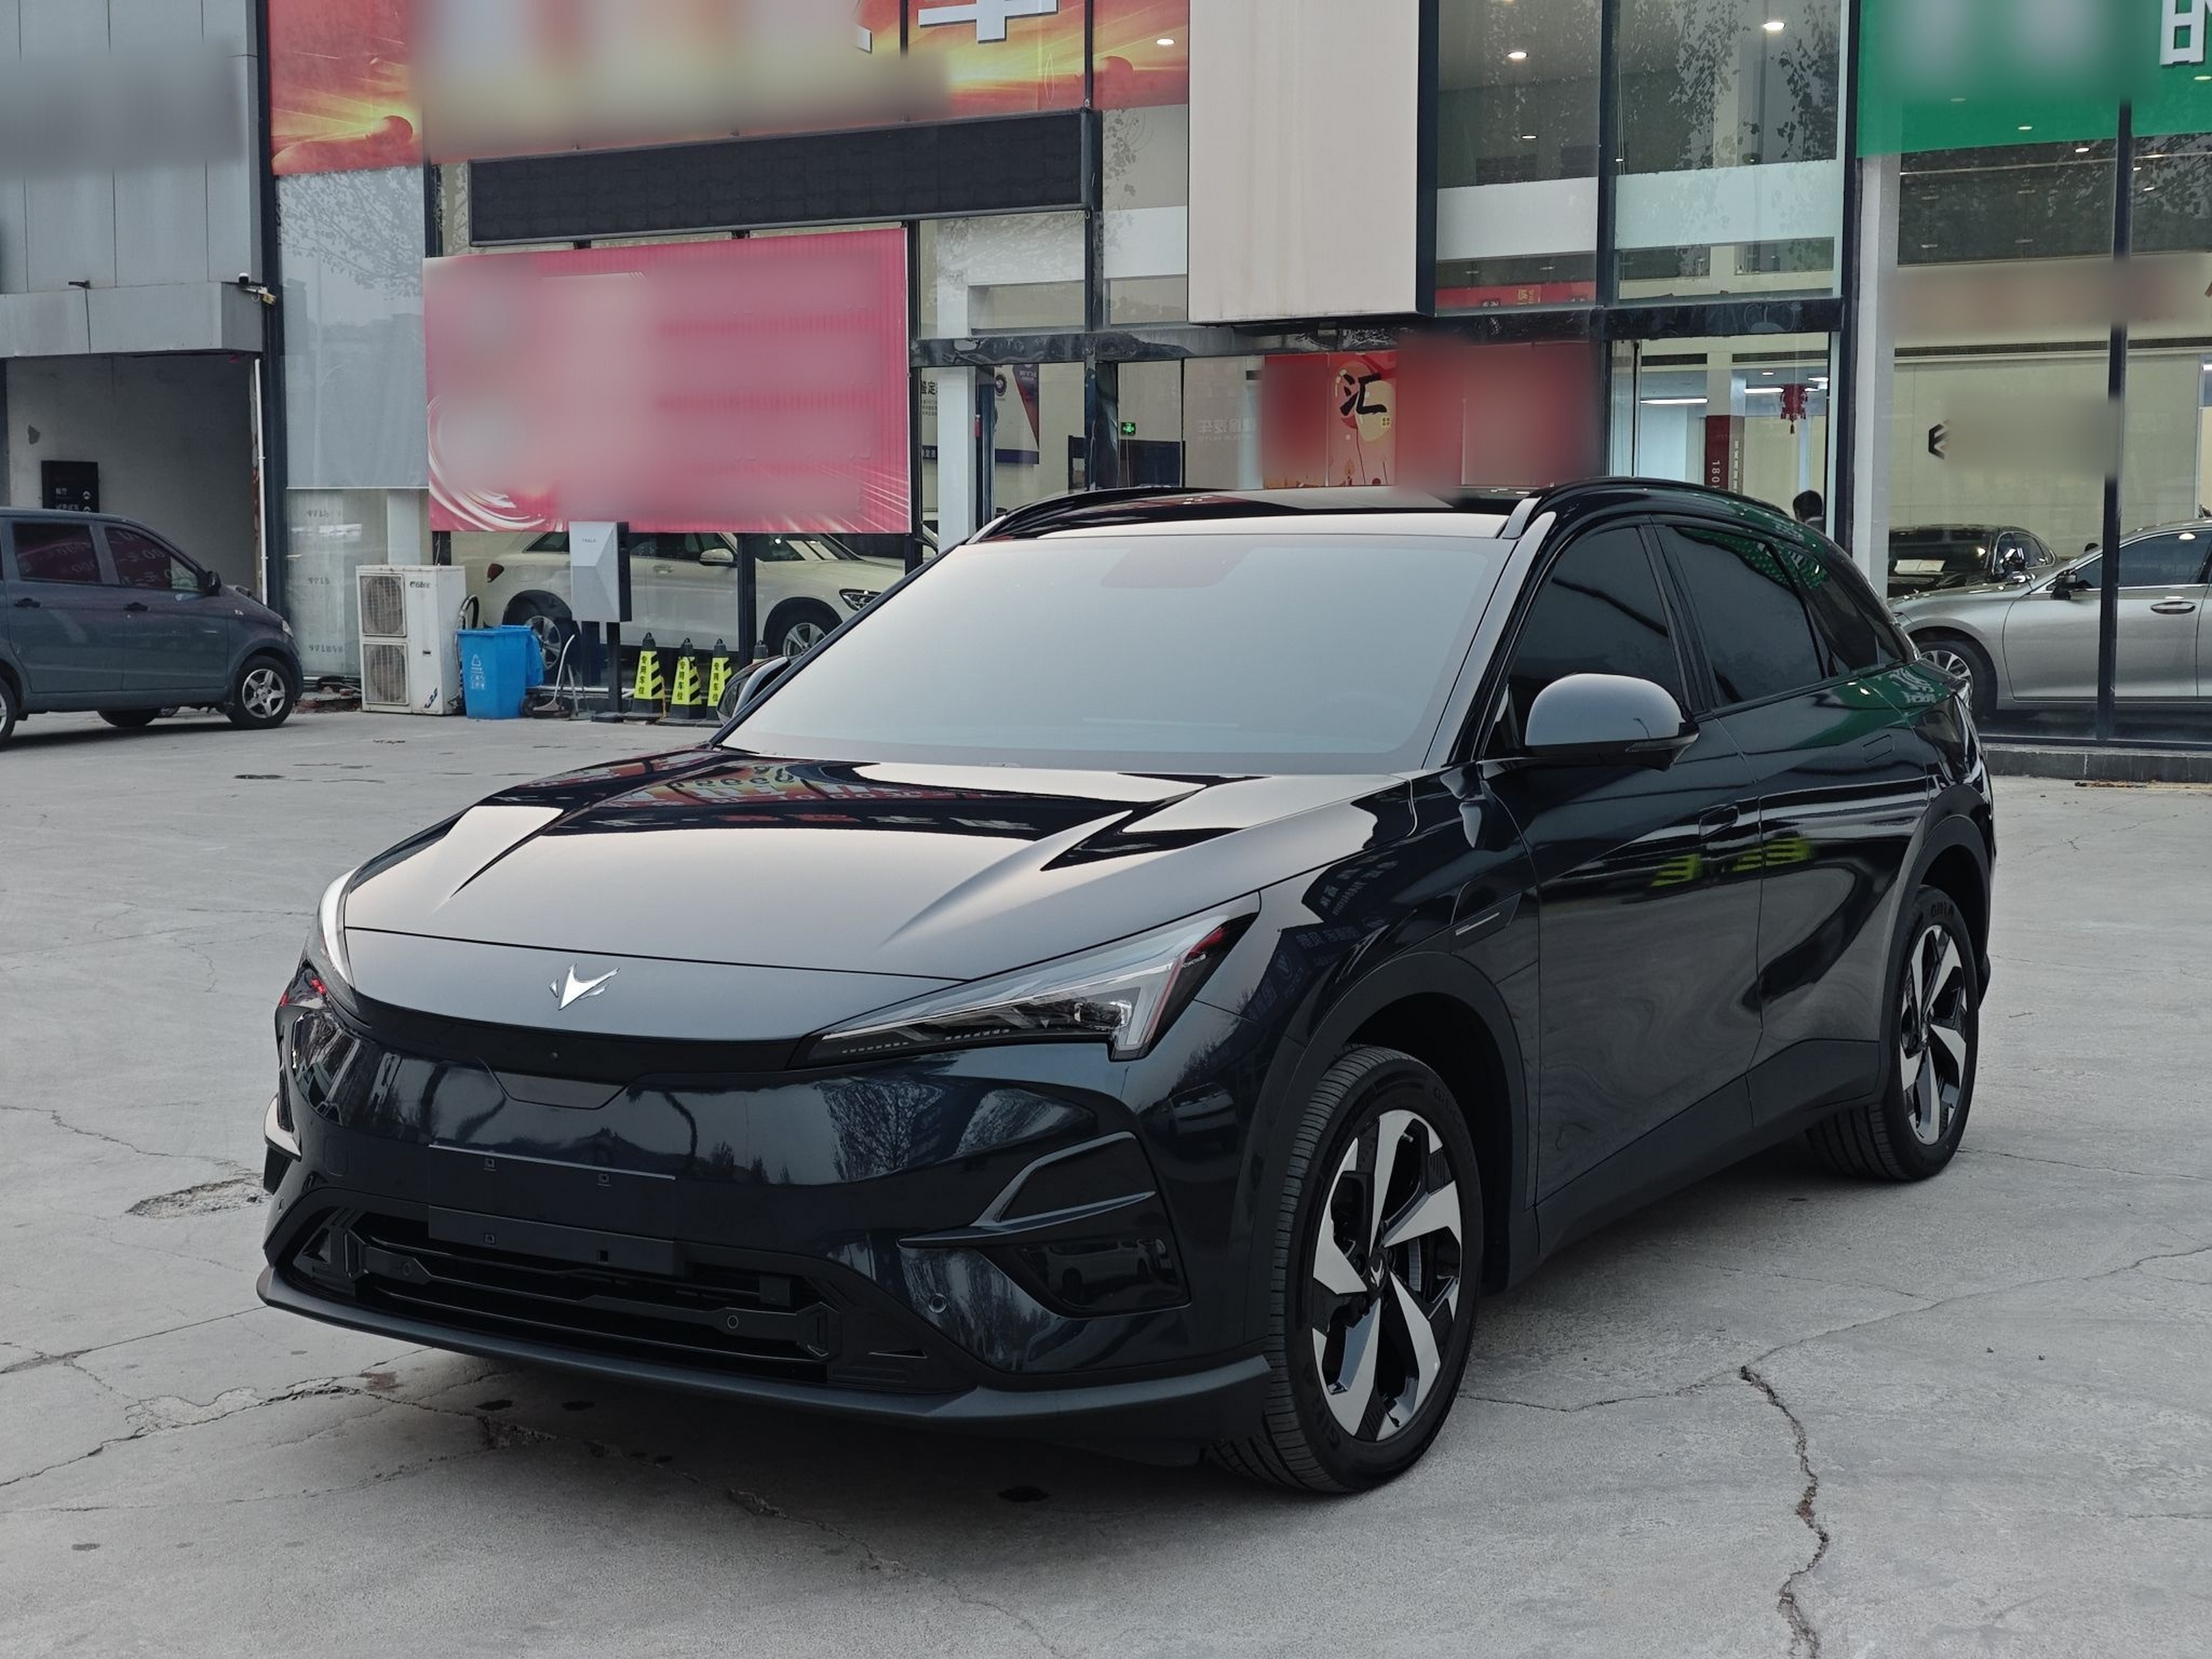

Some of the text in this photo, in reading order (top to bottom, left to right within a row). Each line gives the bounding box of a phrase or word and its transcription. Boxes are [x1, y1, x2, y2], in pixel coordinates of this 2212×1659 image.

[921, 380, 938, 395] 鉴定
[1340, 373, 1387, 416] 汇
[638, 656, 647, 694] 专用车位
[677, 661, 685, 700] 专用车位
